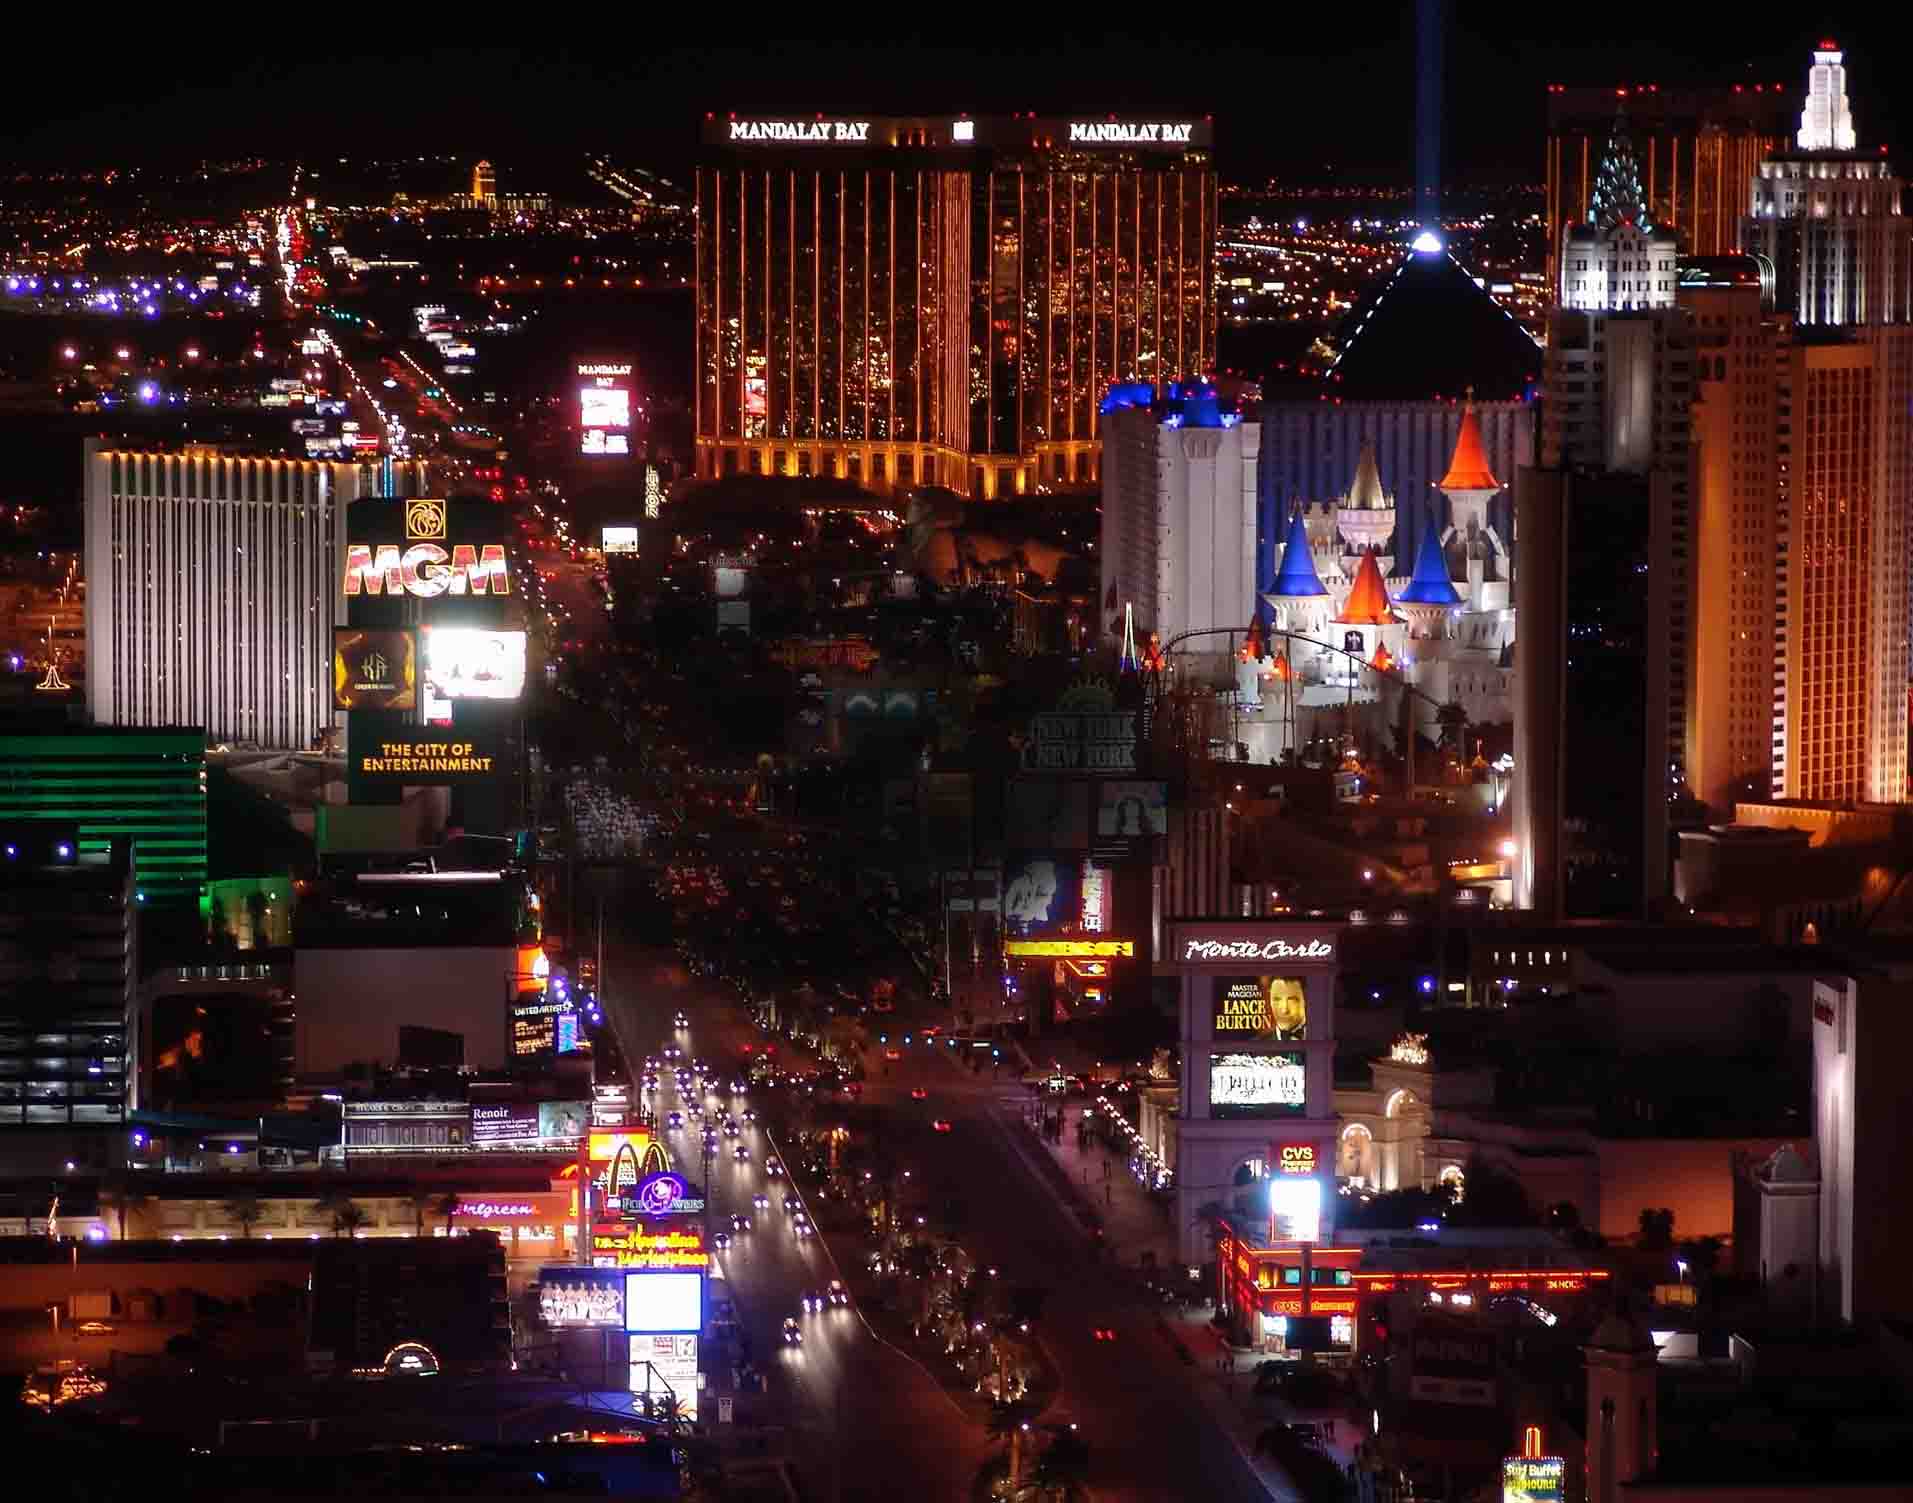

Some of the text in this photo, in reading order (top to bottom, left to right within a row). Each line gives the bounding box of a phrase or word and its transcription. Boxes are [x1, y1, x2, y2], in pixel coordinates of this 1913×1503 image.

[729, 121, 870, 141] MANDALAY BAY
[1069, 123, 1192, 141] MANDALAY BAY
[577, 364, 632, 375] MANDALAY
[343, 543, 510, 597] MGM
[382, 743, 473, 757] THE CITY OF
[362, 758, 493, 771] ENTERTAINMENT
[1185, 939, 1332, 960] Monte Carlo
[514, 1005, 539, 1016] UNITED
[1223, 1000, 1266, 1015] LANCE
[1216, 1014, 1272, 1030] BURTON
[472, 1107, 509, 1119] Renoir
[1282, 1146, 1313, 1160] CVS
[1273, 1301, 1302, 1313] CVS
[1528, 1464, 1561, 1477] Buffet
